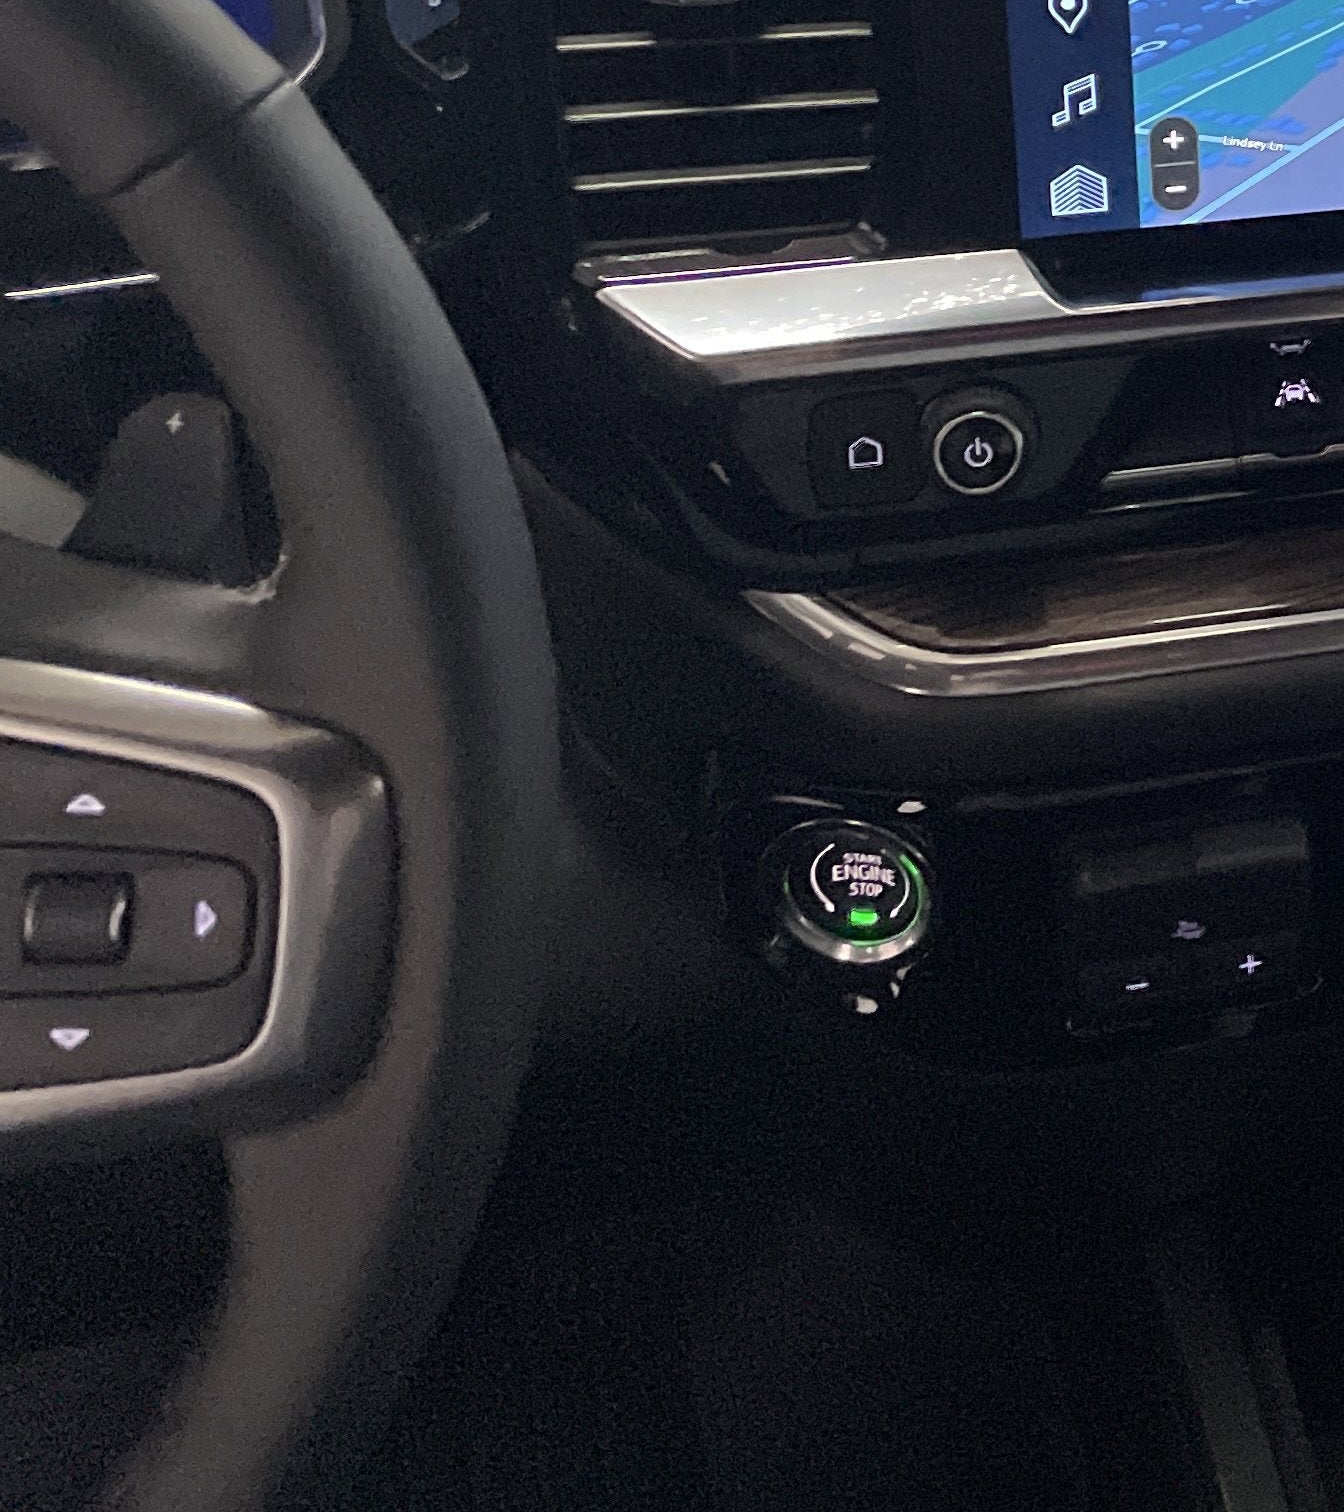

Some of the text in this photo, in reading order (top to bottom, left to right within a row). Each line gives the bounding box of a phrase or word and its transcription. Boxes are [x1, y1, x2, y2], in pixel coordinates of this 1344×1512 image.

[1223, 136, 1284, 152] Lindsey Ln
[832, 864, 896, 886] ENGINE
[848, 882, 883, 897] STOP
